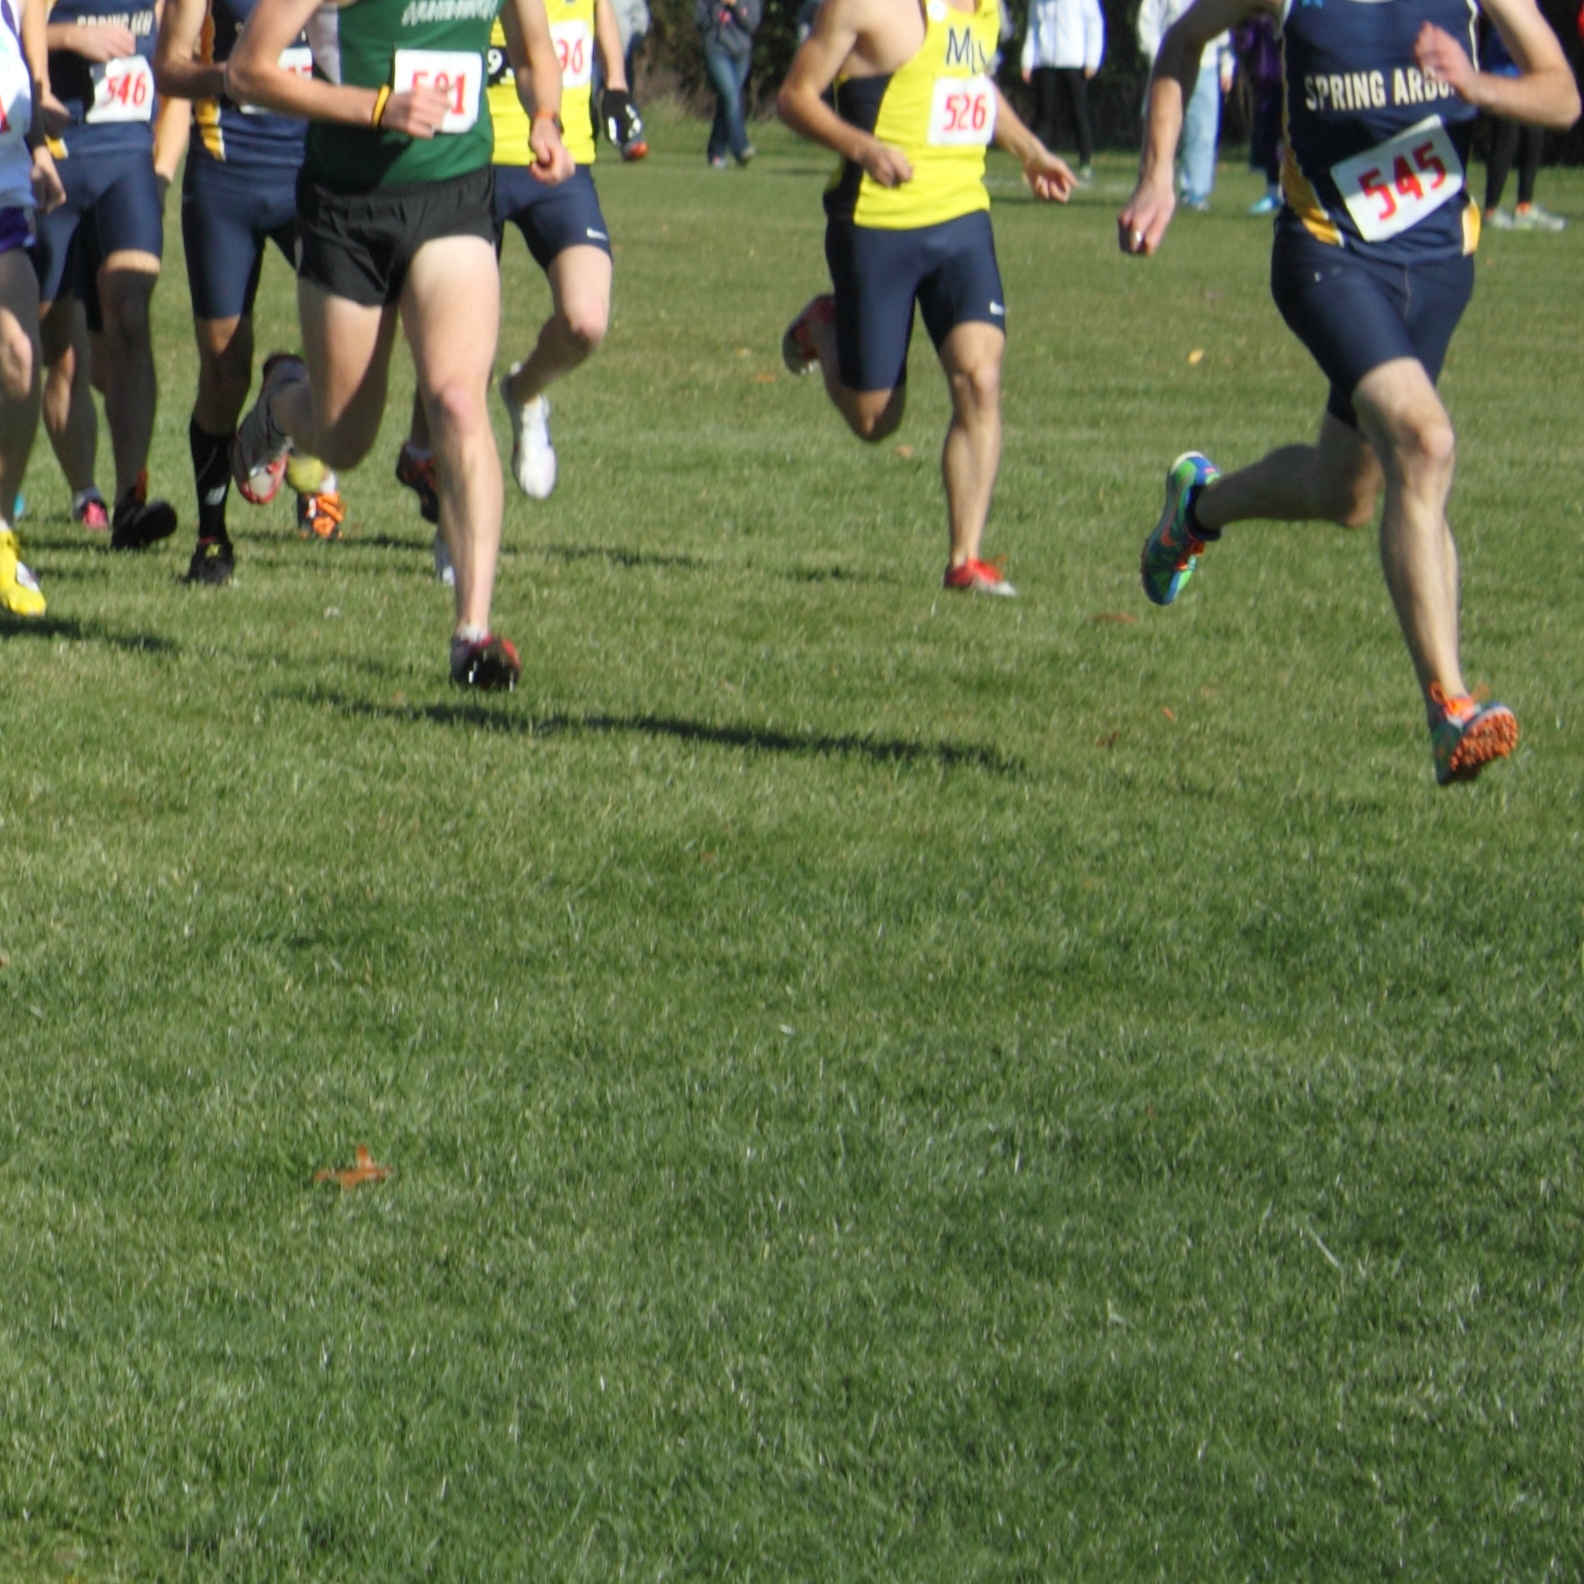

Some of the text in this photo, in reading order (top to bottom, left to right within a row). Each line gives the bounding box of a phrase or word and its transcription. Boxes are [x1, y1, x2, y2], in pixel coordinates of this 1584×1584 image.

[1304, 66, 1456, 111] SPRING ARBO
[942, 93, 987, 132] 526
[1357, 140, 1448, 221] 545
